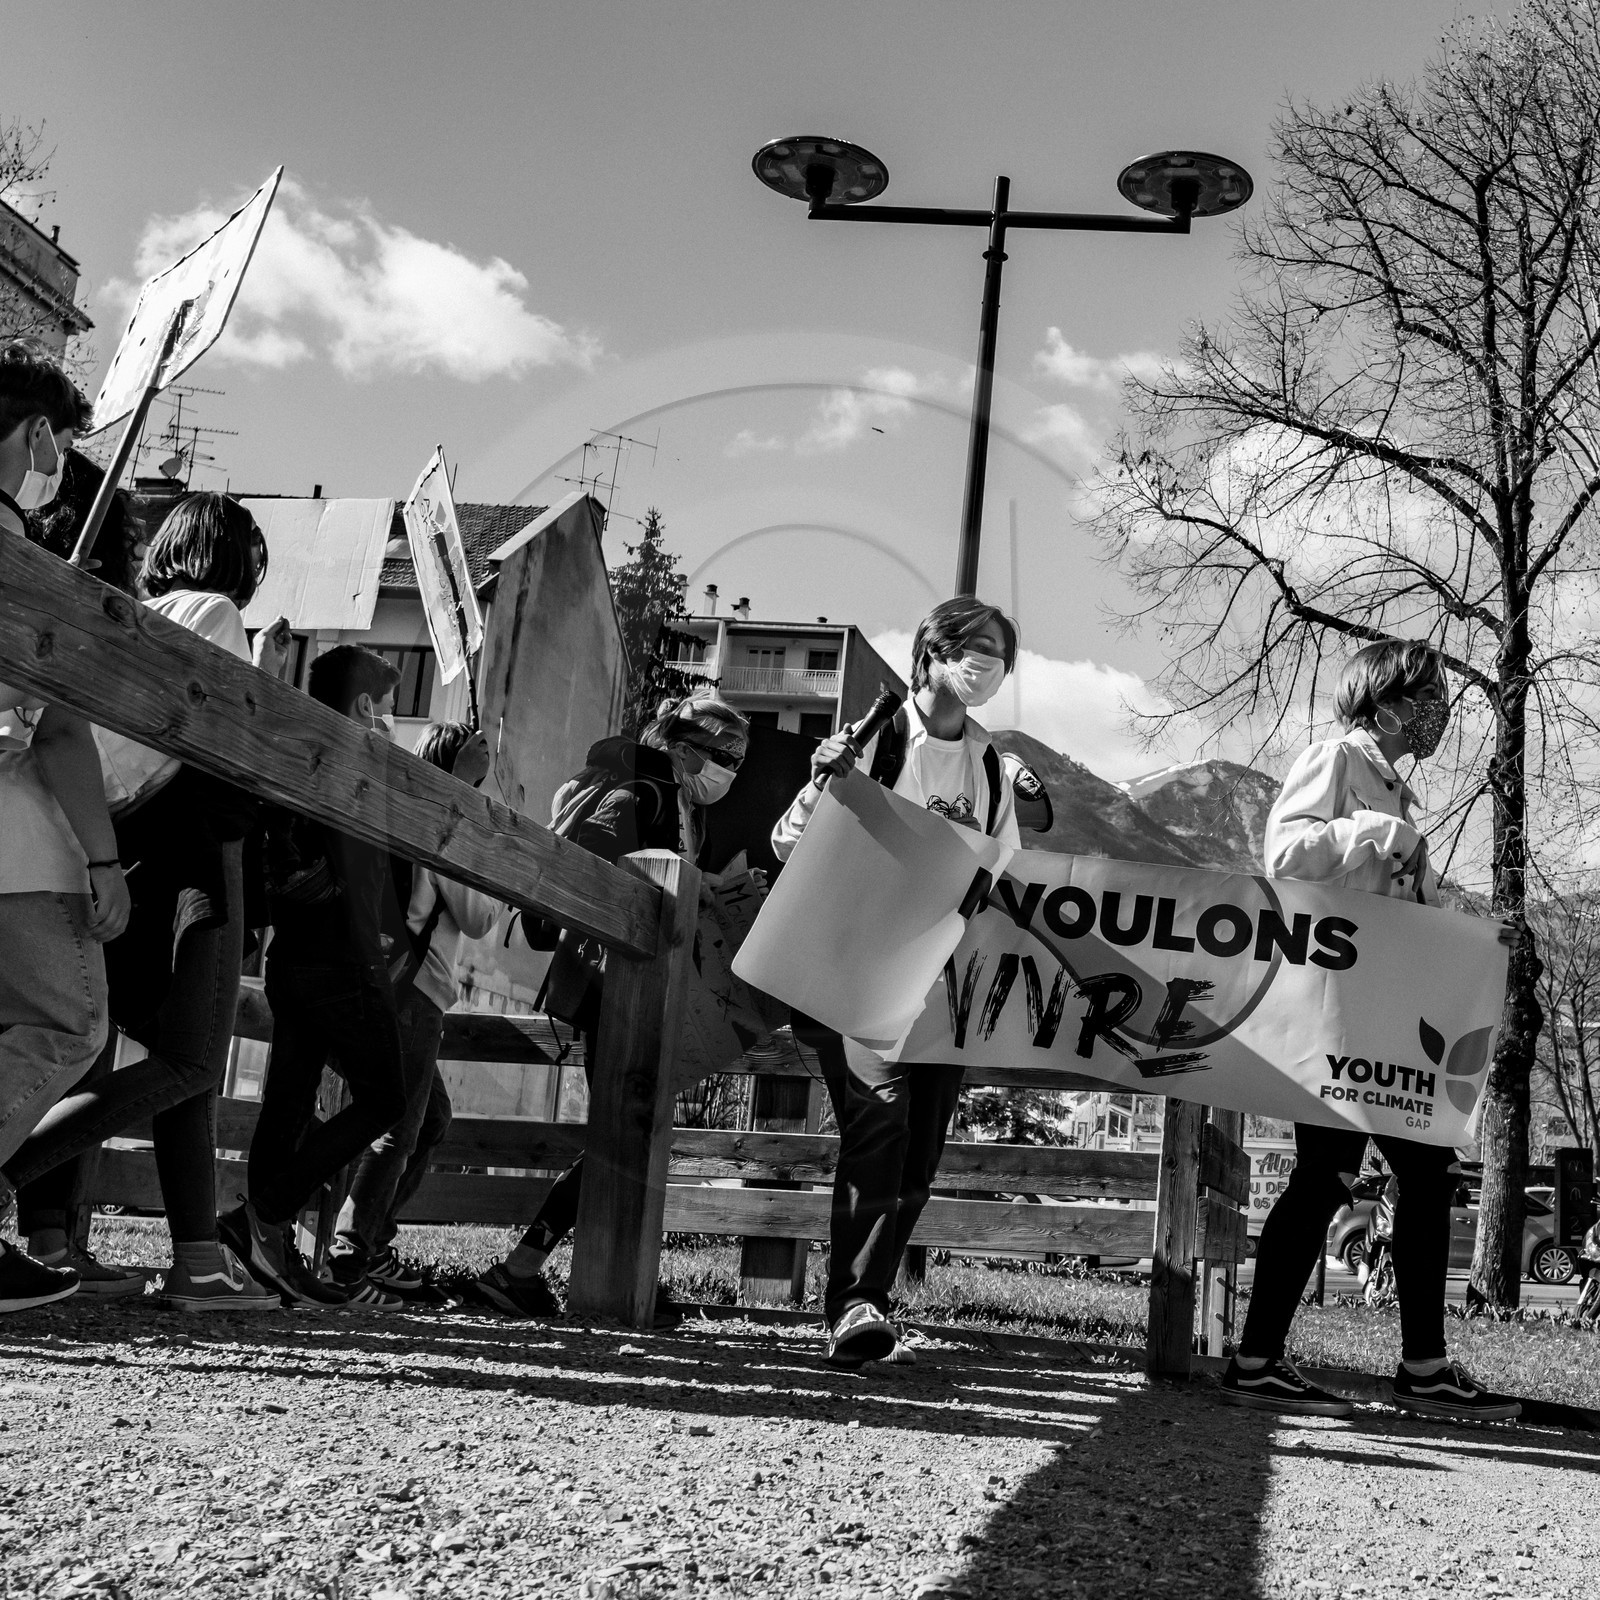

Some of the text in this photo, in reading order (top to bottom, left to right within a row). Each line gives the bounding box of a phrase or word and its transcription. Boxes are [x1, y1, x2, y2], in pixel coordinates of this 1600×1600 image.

[997, 878, 1360, 971] VOULONS
[943, 948, 1217, 1078] VIVRE
[1326, 1054, 1436, 1097] YOUTH
[1320, 1085, 1434, 1116] FOR CLIMATE
[1405, 1116, 1431, 1130] GAP
